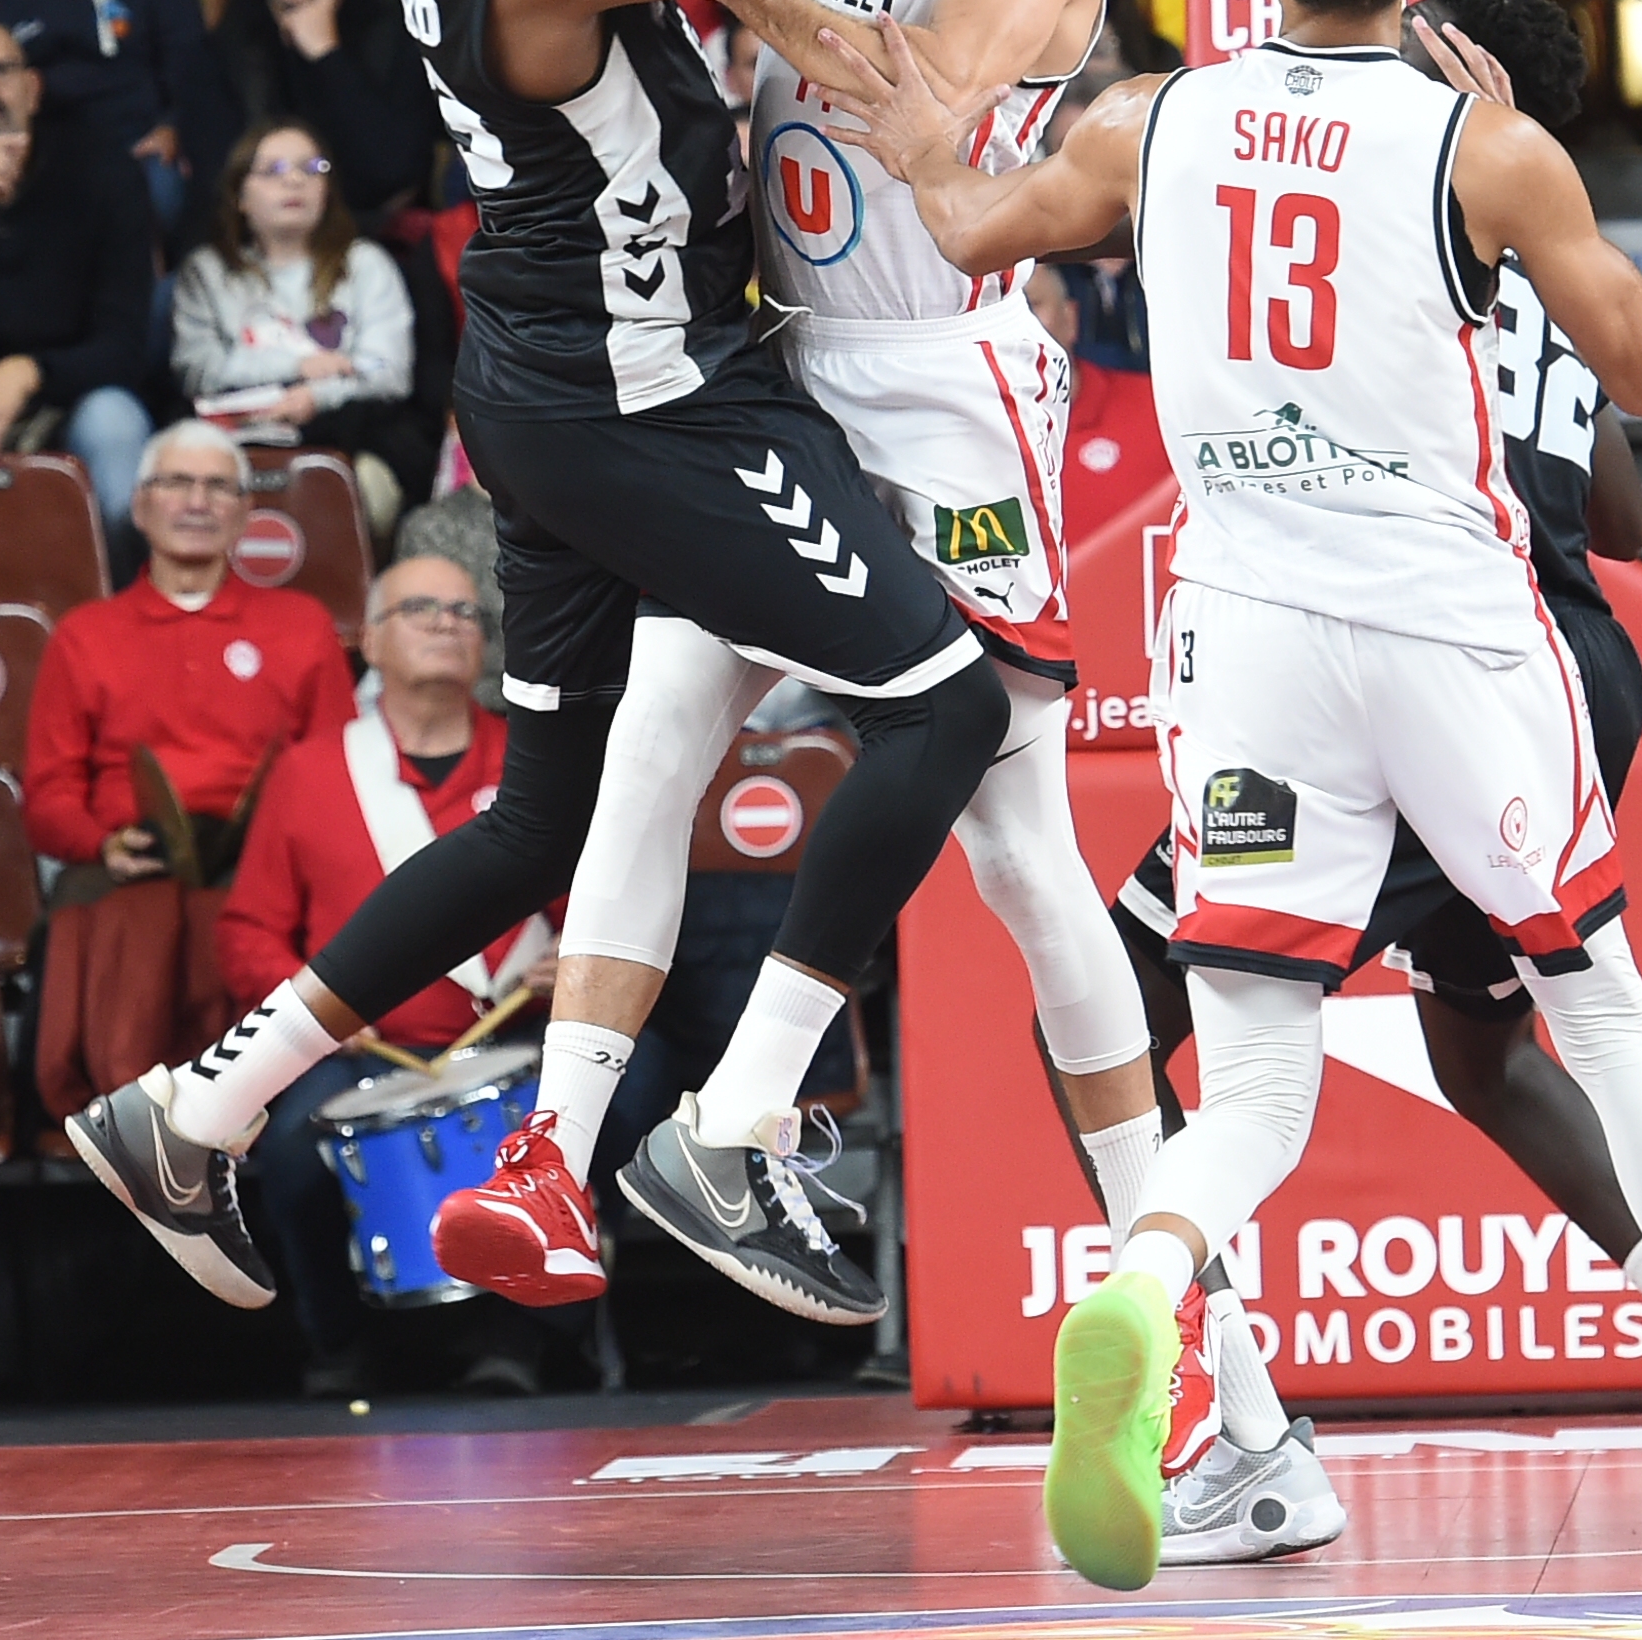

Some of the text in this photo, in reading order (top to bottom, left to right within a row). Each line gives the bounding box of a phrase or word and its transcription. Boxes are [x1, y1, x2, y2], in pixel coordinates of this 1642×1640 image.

[1234, 108, 1351, 174] SAKO
[1215, 184, 1340, 371] 13
[1300, 474, 1328, 492] et
[957, 558, 1022, 575] HOLET
[1206, 810, 1267, 828] L'AUTRE
[1206, 828, 1287, 846] FAUBOURG
[1298, 1212, 1639, 1298] ROUYE
